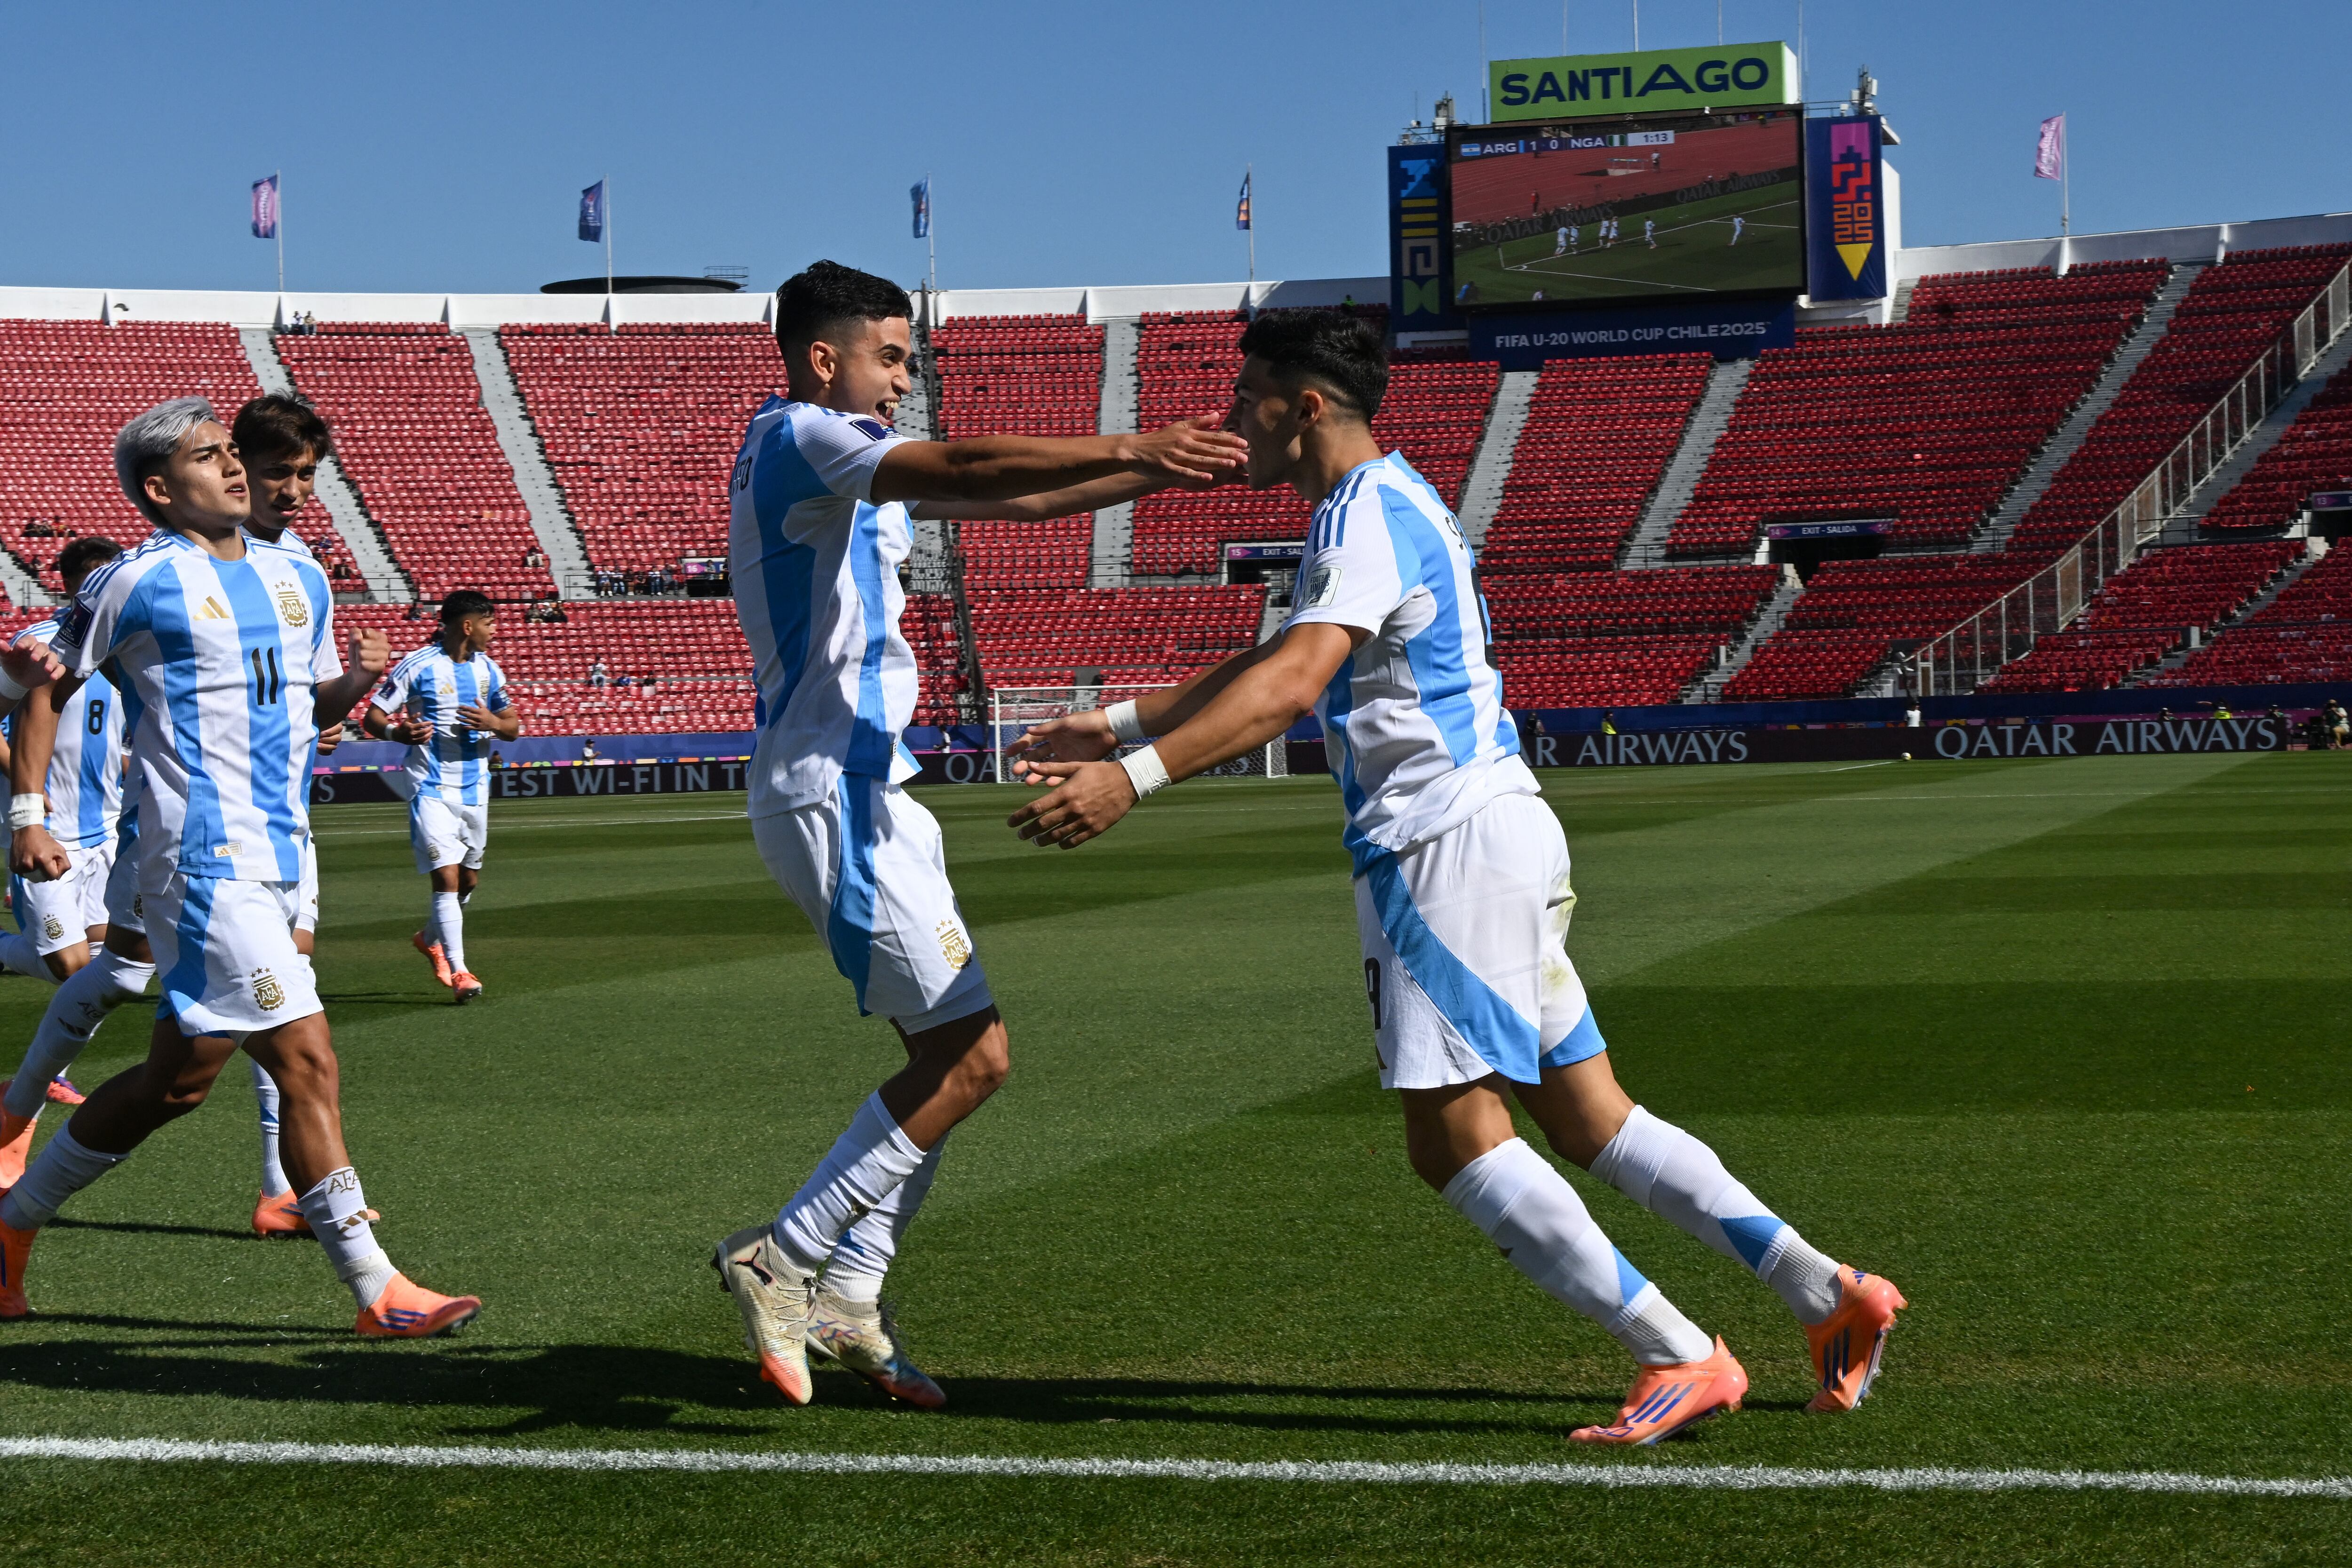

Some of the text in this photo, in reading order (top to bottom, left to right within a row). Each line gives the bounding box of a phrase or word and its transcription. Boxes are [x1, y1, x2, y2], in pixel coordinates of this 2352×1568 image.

[1500, 57, 1768, 106] SANTIAGO
[1483, 133, 1667, 154] ARG 1 0 NGA 1:13
[1676, 170, 1780, 203] QATAR AIRWAYS
[1487, 204, 1614, 243] QATAR AIRWAYS
[1496, 335, 1530, 348] FIFA
[1533, 333, 1568, 345] U-20
[1571, 330, 1629, 344] WORLD
[1632, 328, 1663, 341] CUP
[285, 599, 302, 617] AFA
[252, 647, 279, 706] 11
[88, 699, 104, 735] 8
[1576, 732, 1748, 766] AIRWAYS
[1935, 719, 2277, 759] QATAR AIRWAYS
[571, 766, 661, 794] WI-FI
[675, 764, 709, 791] IN
[948, 939, 966, 959] AFA
[260, 984, 279, 1001] AFA
[1365, 957, 1381, 1030] 9
